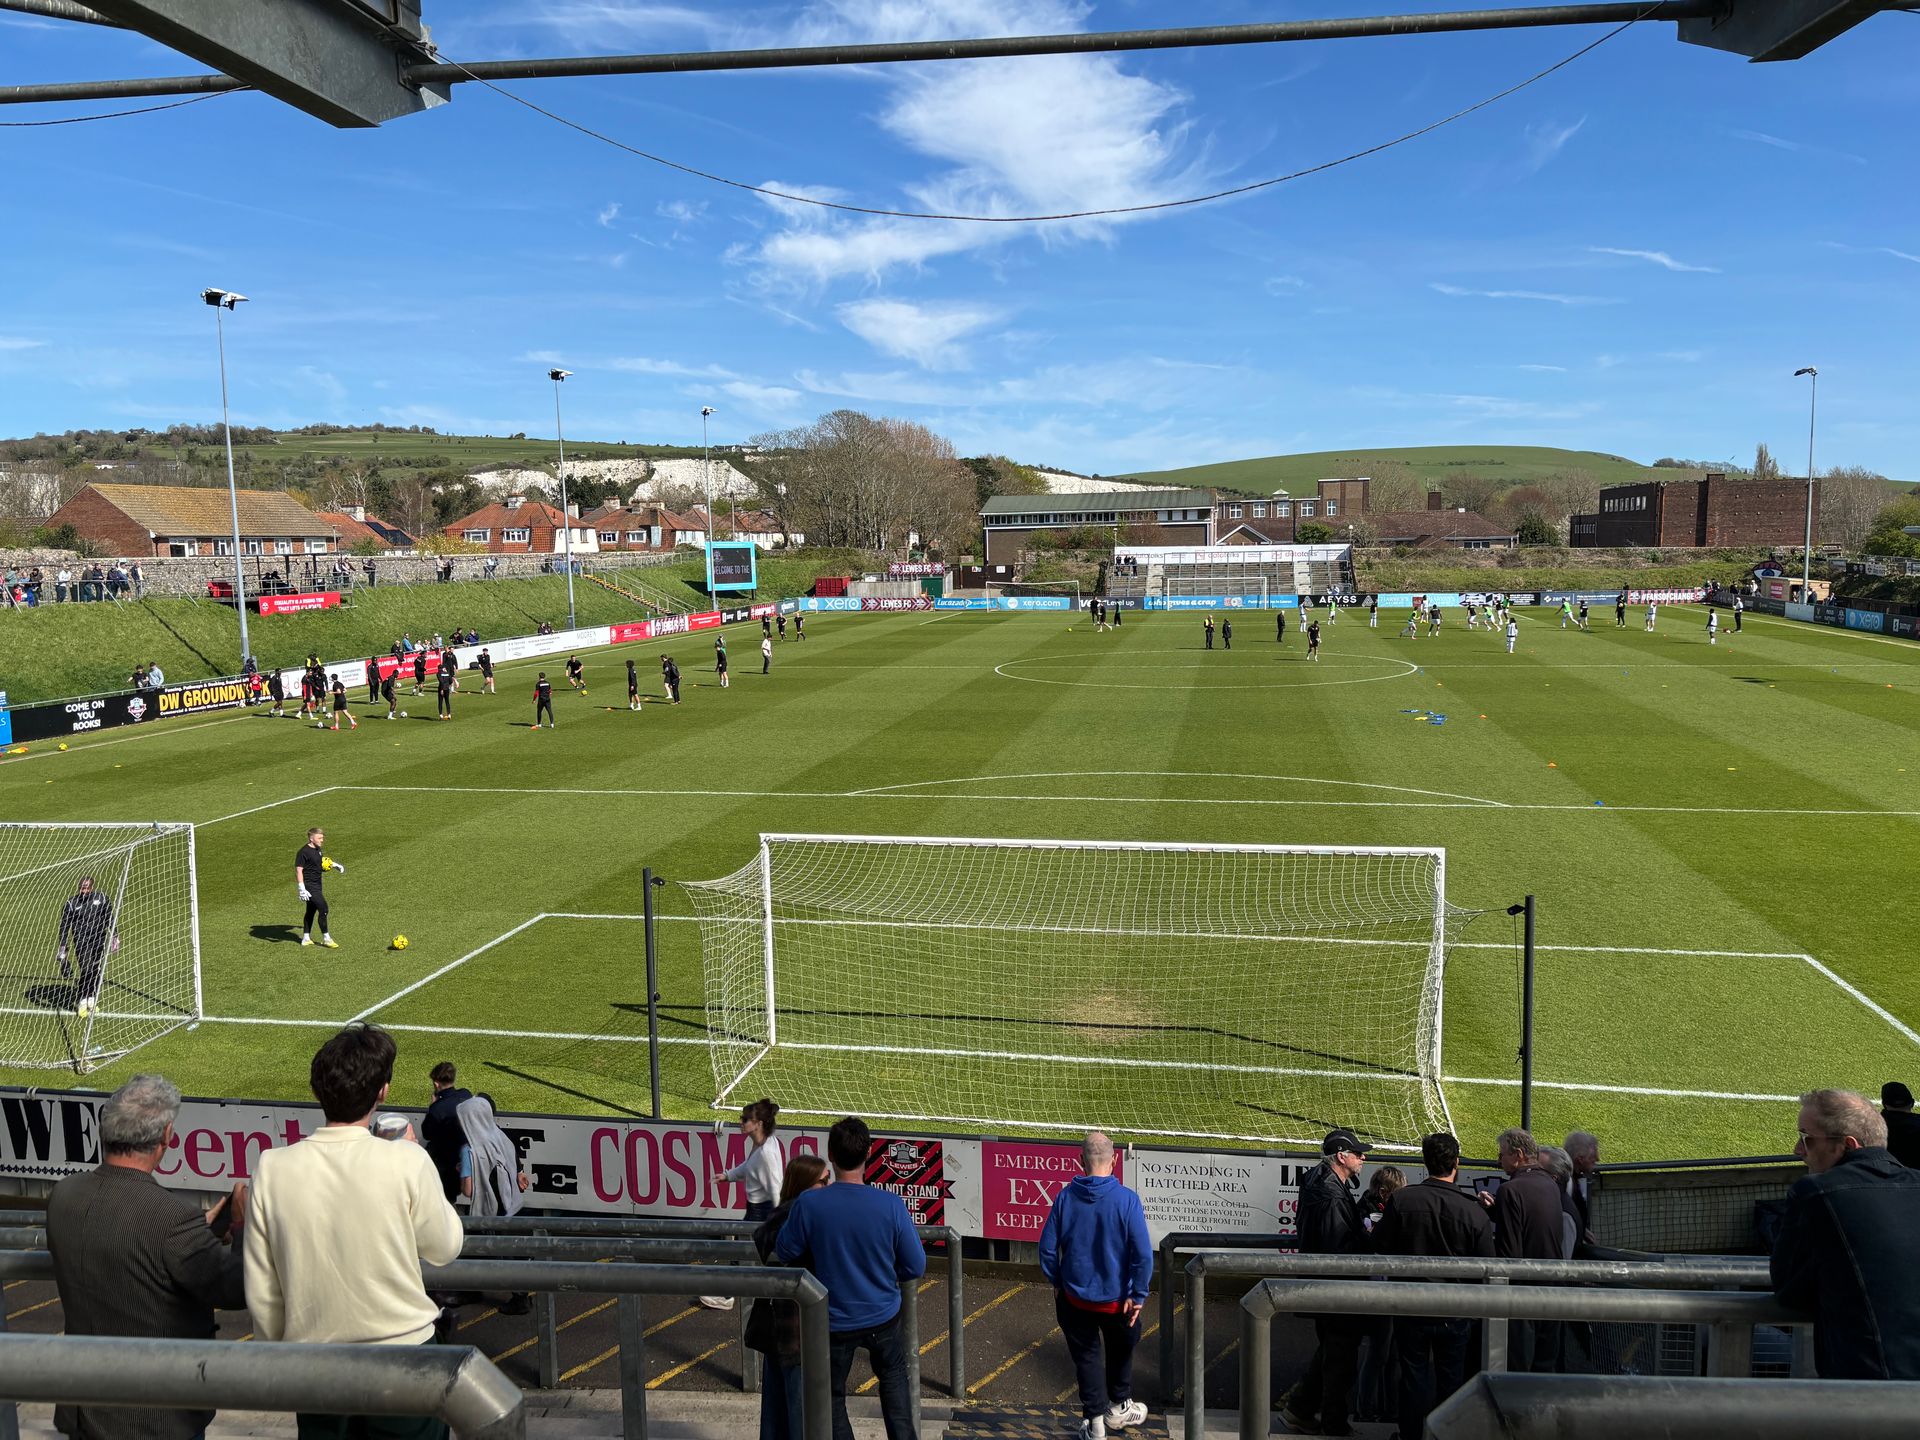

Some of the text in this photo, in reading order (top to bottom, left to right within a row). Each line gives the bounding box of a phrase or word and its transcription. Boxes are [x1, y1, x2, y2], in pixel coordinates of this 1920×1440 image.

[741, 564, 750, 573] THE
[902, 564, 932, 573] LEWES FC
[1641, 592, 1694, 601] #FANSOFCHANGE
[826, 600, 859, 609] xero
[880, 600, 912, 608] LEWES FC
[1860, 613, 1880, 629] xero
[65, 700, 105, 713] COME ON
[159, 693, 180, 712] DW
[77, 711, 95, 720] YOU
[73, 719, 101, 731] ROOKS!
[889, 1161, 918, 1170] LEWES
[1141, 1162, 1251, 1179] NO STANDING IN
[886, 1183, 905, 1196] NOT
[907, 1184, 939, 1197] STAND
[1145, 1177, 1248, 1194] HATCHED AREA
[902, 1197, 920, 1211] THE
[1144, 1197, 1249, 1209] ABUSIVE LANGUAGE COULD
[1143, 1205, 1250, 1218] RESULT IN THOSE INVOLVED
[996, 1212, 1044, 1230] KEEP
[1144, 1213, 1249, 1227] BEING EXPELLED FROM THE
[1178, 1224, 1213, 1233] GROUND
